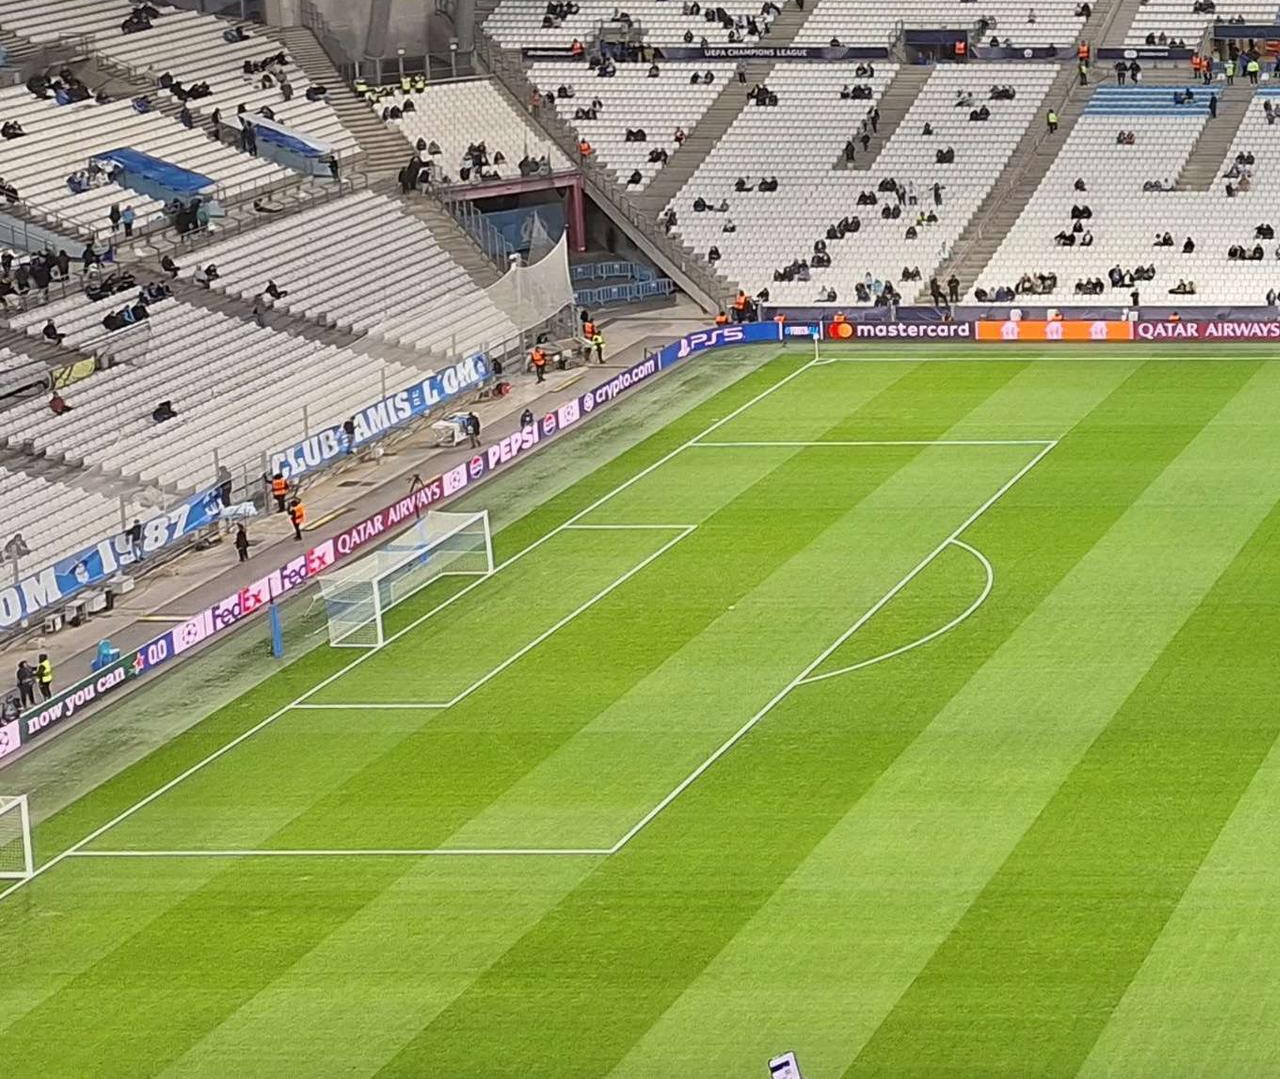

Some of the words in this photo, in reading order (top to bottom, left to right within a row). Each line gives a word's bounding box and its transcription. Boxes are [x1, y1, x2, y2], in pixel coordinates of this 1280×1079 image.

[690, 327, 743, 346] PS5
[856, 322, 970, 338] mastercard
[1138, 322, 1199, 339] QATAR
[1205, 322, 1280, 338] AIRWAYS
[596, 359, 655, 404] crypto.com
[353, 392, 412, 442] AMIS
[272, 429, 340, 478] CLUB
[488, 420, 540, 470] PEPSI
[97, 503, 190, 573] 1987
[337, 519, 385, 554] QATAR
[388, 482, 441, 528] AIRWAYS
[281, 548, 327, 588] FedEx
[212, 587, 262, 632] FedEx
[27, 702, 63, 735] now
[63, 684, 95, 718] you
[97, 666, 125, 694] can
